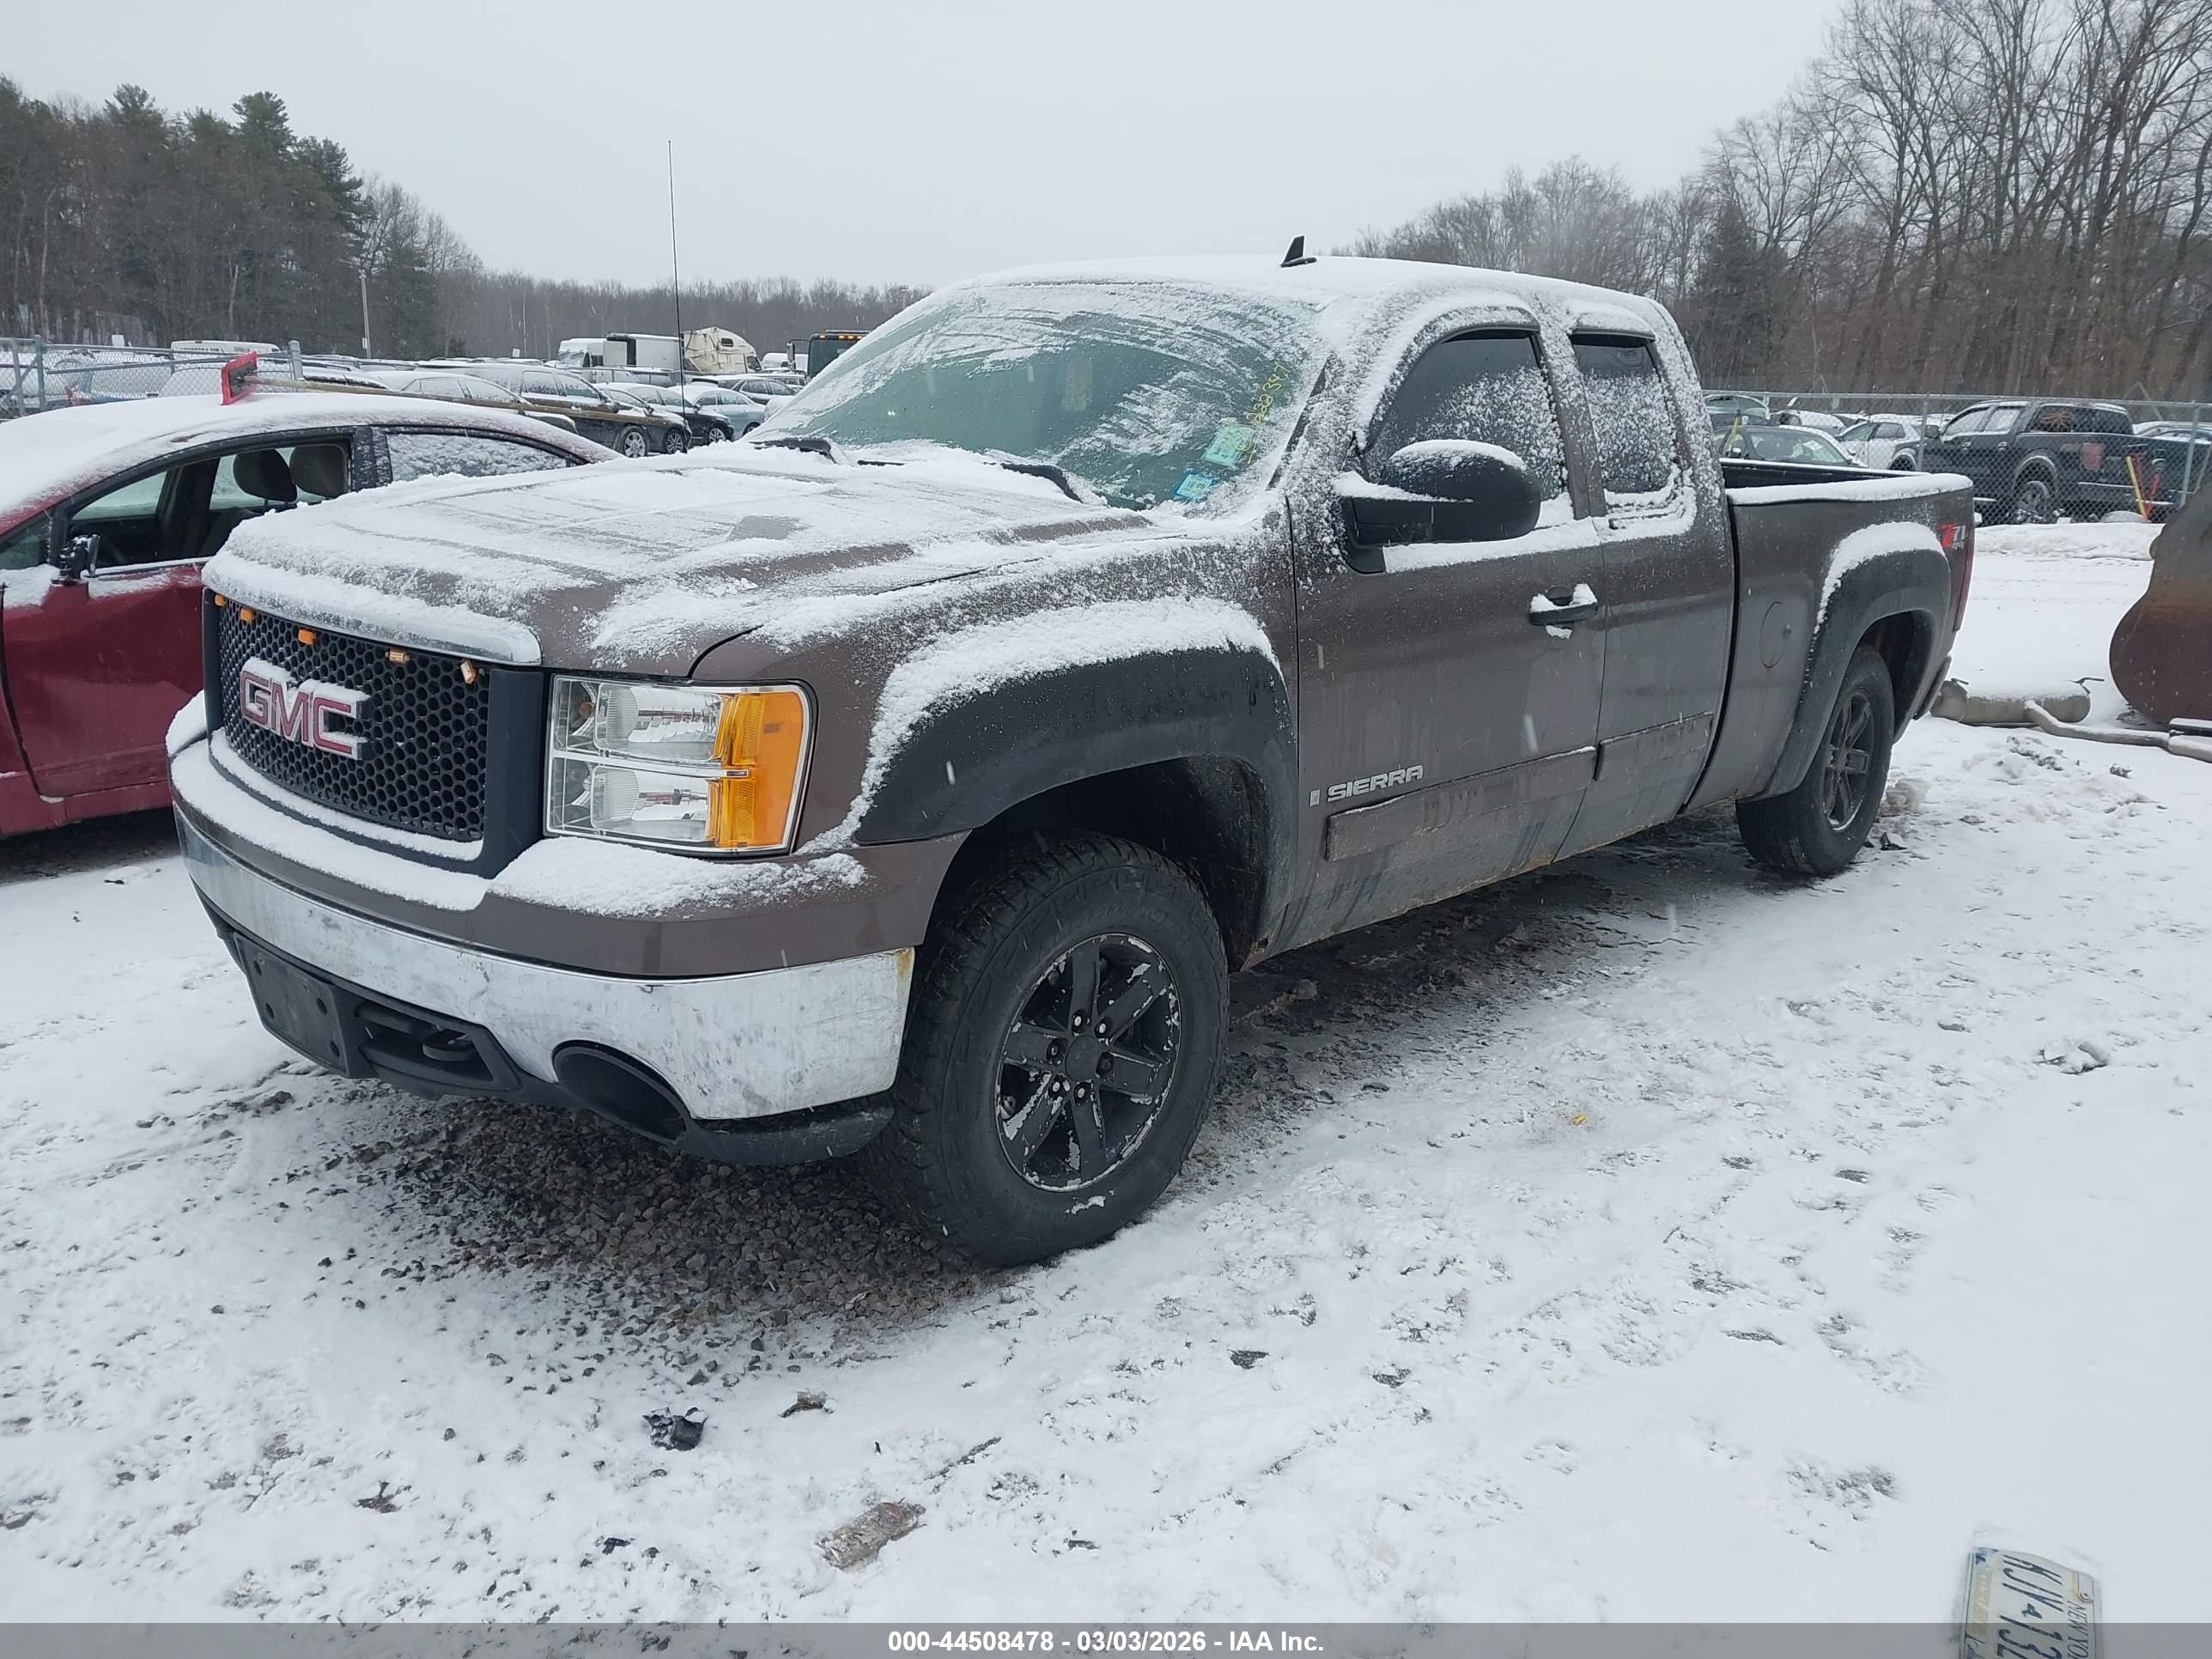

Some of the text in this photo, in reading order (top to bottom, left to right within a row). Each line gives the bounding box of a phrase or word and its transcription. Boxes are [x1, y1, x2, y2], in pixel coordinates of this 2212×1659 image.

[240, 669, 361, 761] GMC
[1326, 764, 1424, 803] SIERRA
[2067, 1600, 2089, 1659] NEW YO
